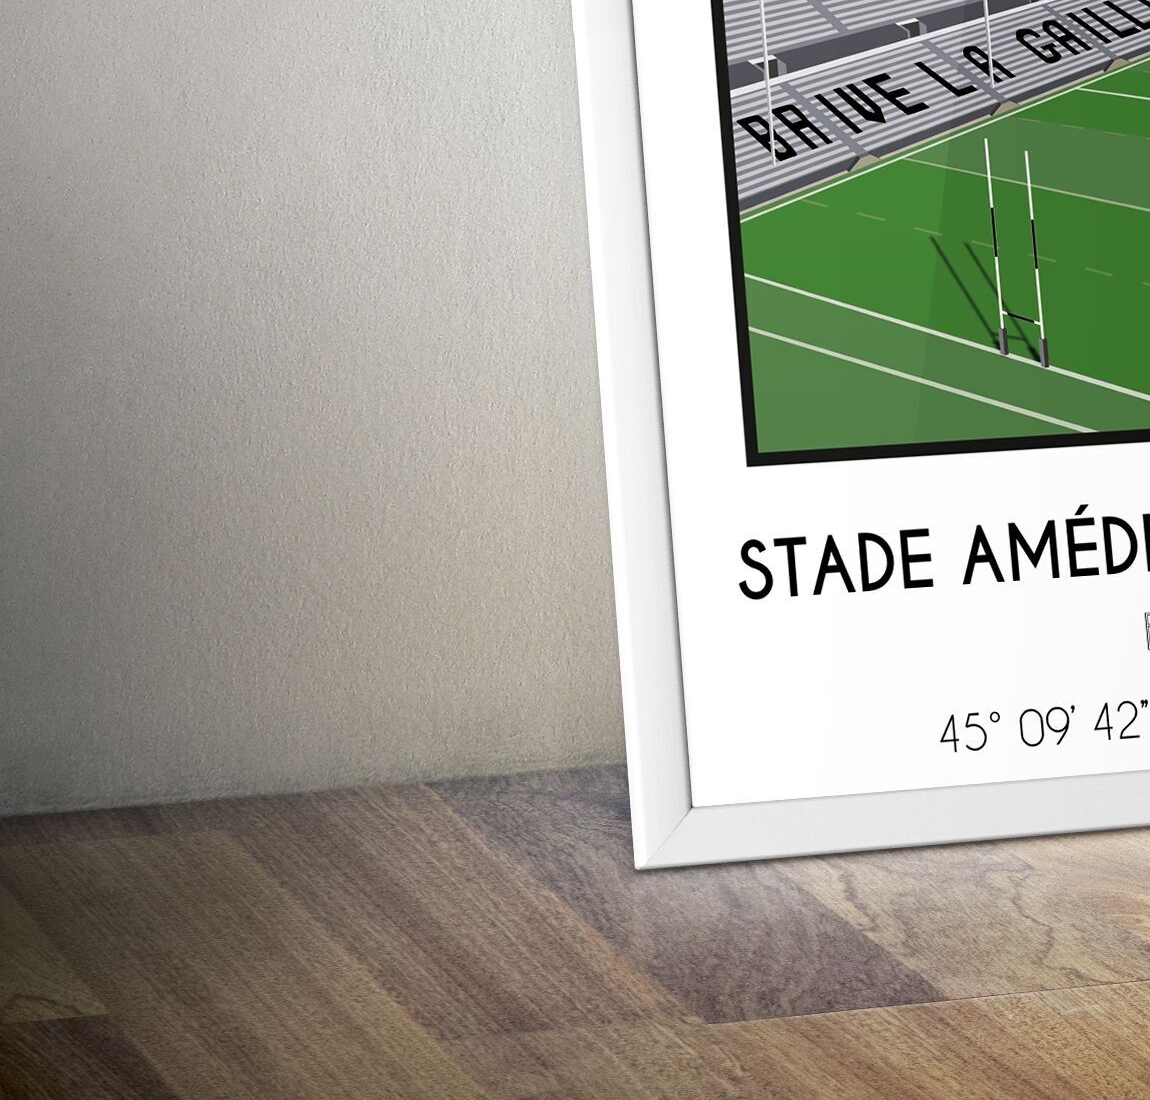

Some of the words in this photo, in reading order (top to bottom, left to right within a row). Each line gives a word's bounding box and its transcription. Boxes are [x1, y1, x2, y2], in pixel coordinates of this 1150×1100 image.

[736, 72, 930, 162] BRIVE
[914, 45, 1017, 97] LA
[738, 528, 935, 600] STADE
[939, 711, 1001, 753] 45°
